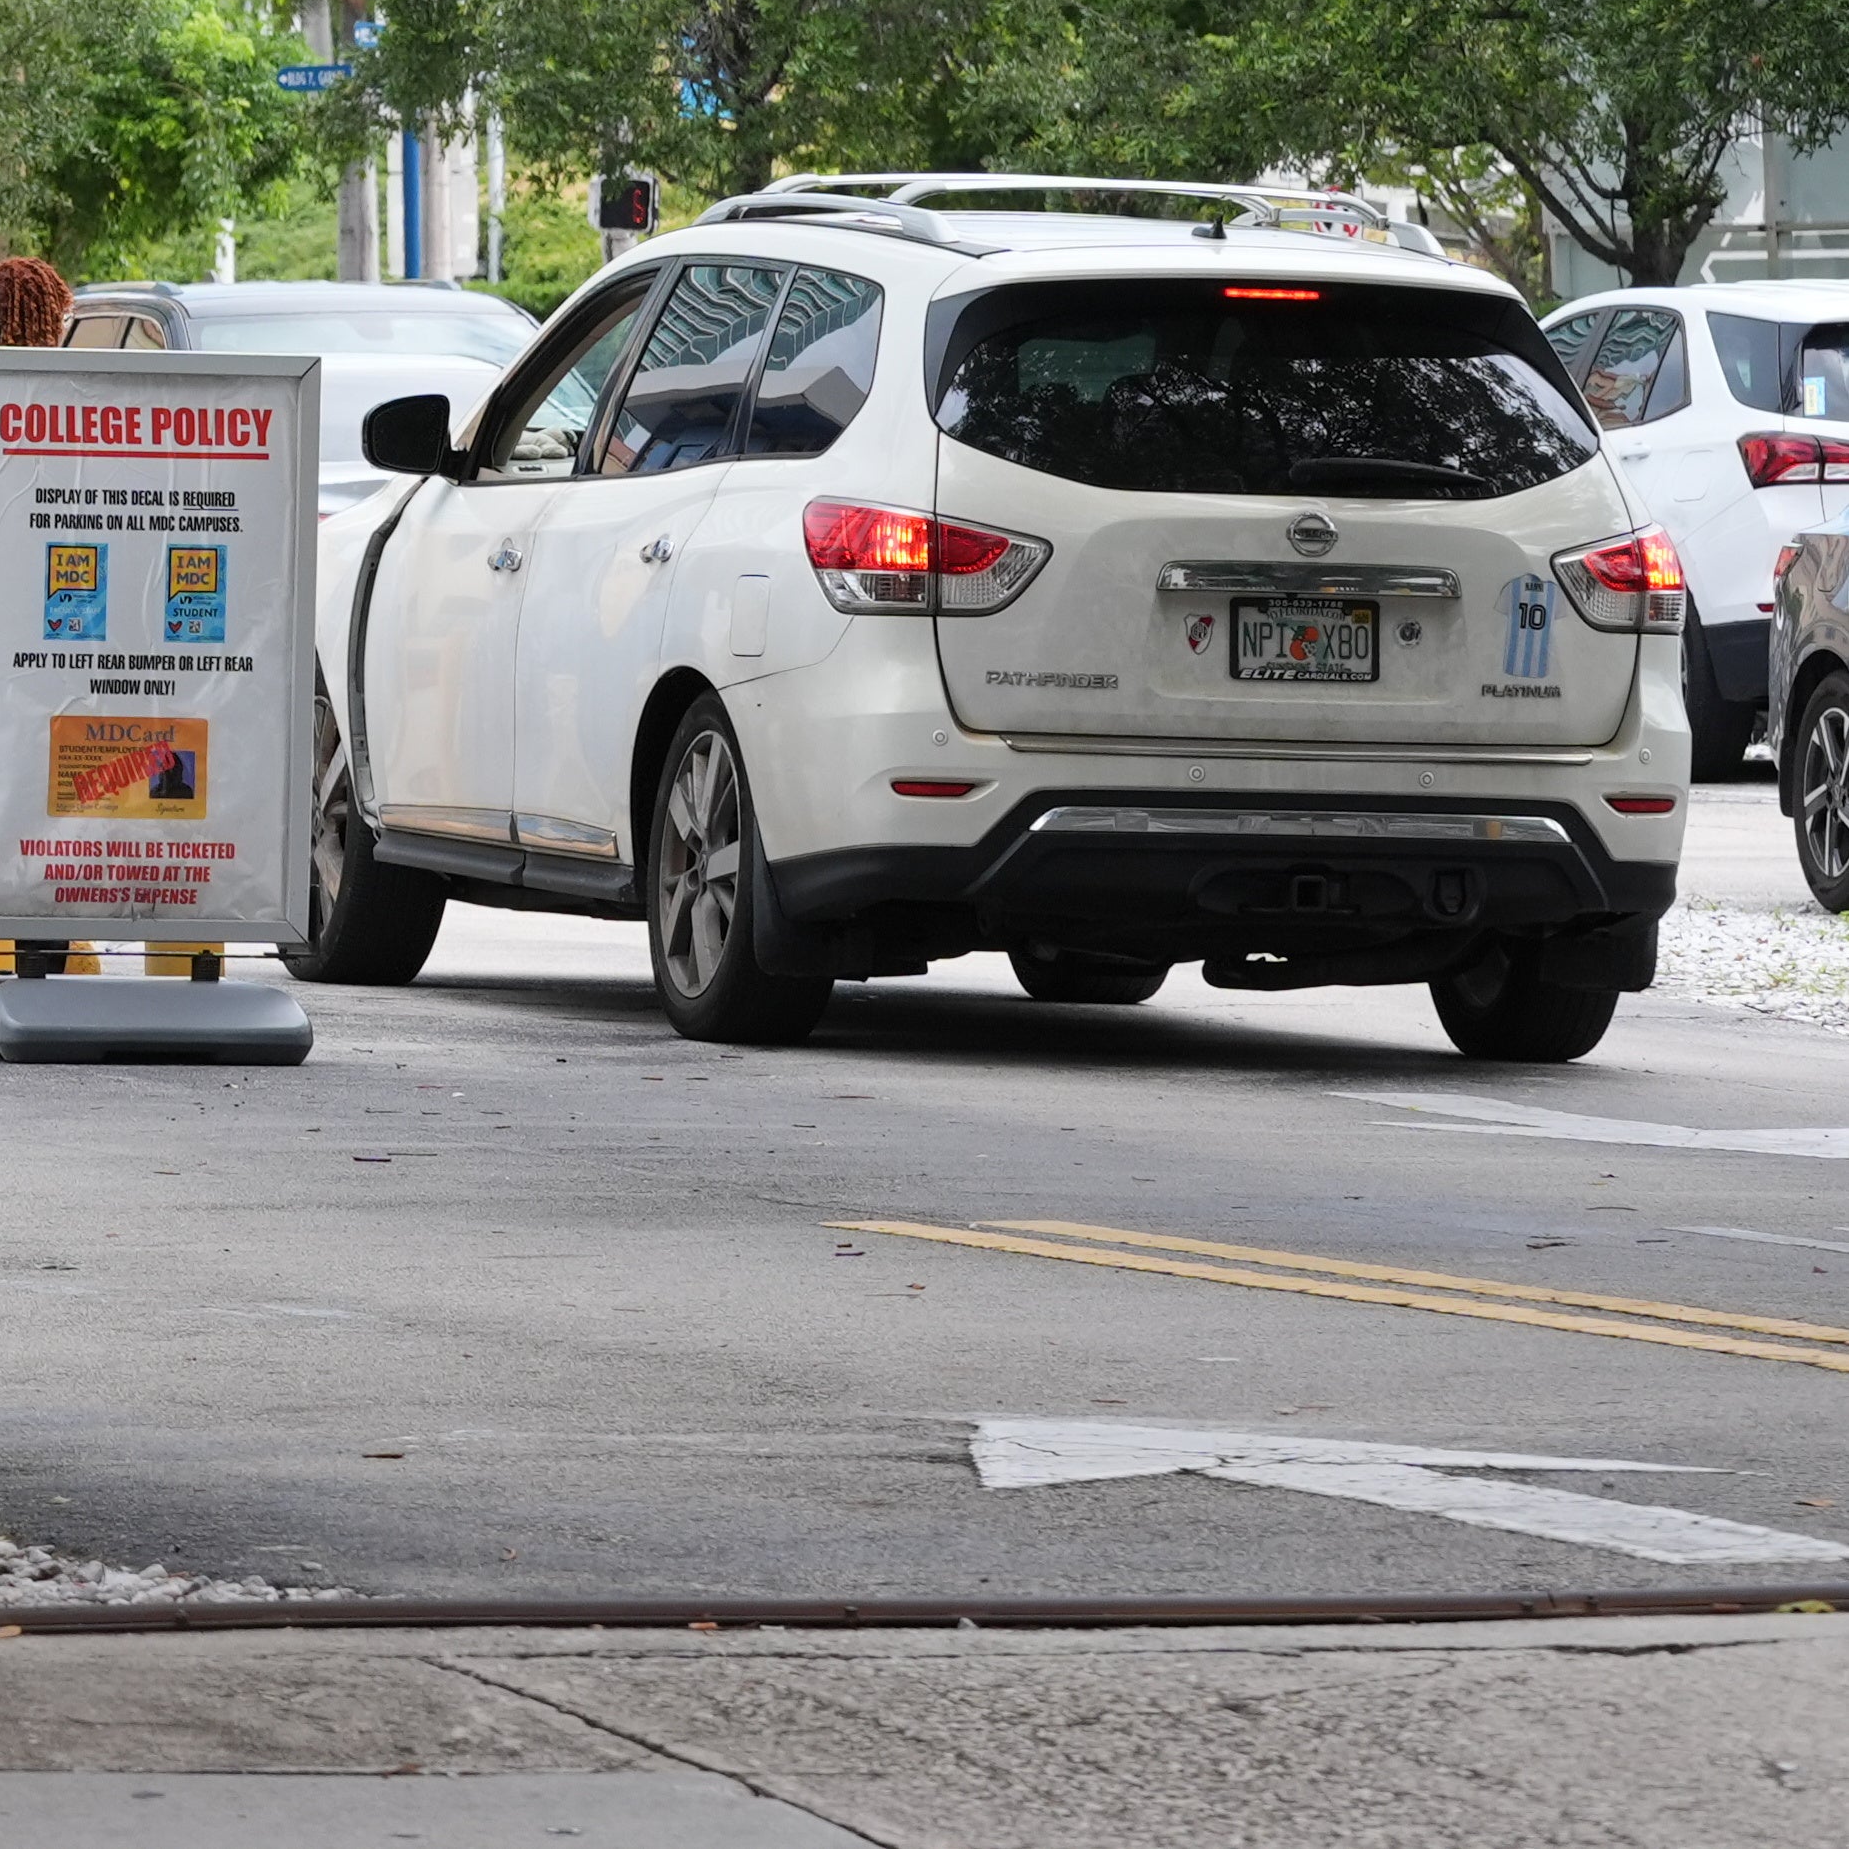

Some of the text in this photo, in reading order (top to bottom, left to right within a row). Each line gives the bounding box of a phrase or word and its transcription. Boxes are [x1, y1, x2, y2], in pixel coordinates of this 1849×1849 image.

[0, 403, 272, 447] COLLEGE POLICY
[36, 489, 235, 509] DISPLAY OF THIS DECAL IS REQUIRED
[30, 513, 243, 533] FOR PARKING ON ALL MDC CAMPUSES.
[57, 554, 89, 567] I AM
[177, 556, 210, 568] I AM
[56, 570, 89, 583] MDC
[176, 573, 210, 585] MDC
[173, 608, 218, 618] STUDENT
[1518, 602, 1547, 631] 10
[13, 653, 253, 672] APPLY TO LEFT REAR BUMPER OR LEFT REAR
[986, 670, 1118, 689] PATHFINDER
[1240, 669, 1297, 679] ELITE
[90, 679, 175, 695] WINDOW ONLY!
[1481, 683, 1562, 698] PLATINUM
[86, 723, 174, 742] MDCard
[73, 741, 176, 804] REQUIRED
[20, 840, 235, 859] VIOLATORS WILL BE TICKETED
[44, 864, 210, 882] AND/OR TOWED AT THE
[55, 887, 197, 904] OWNERS'S EXPENSE
